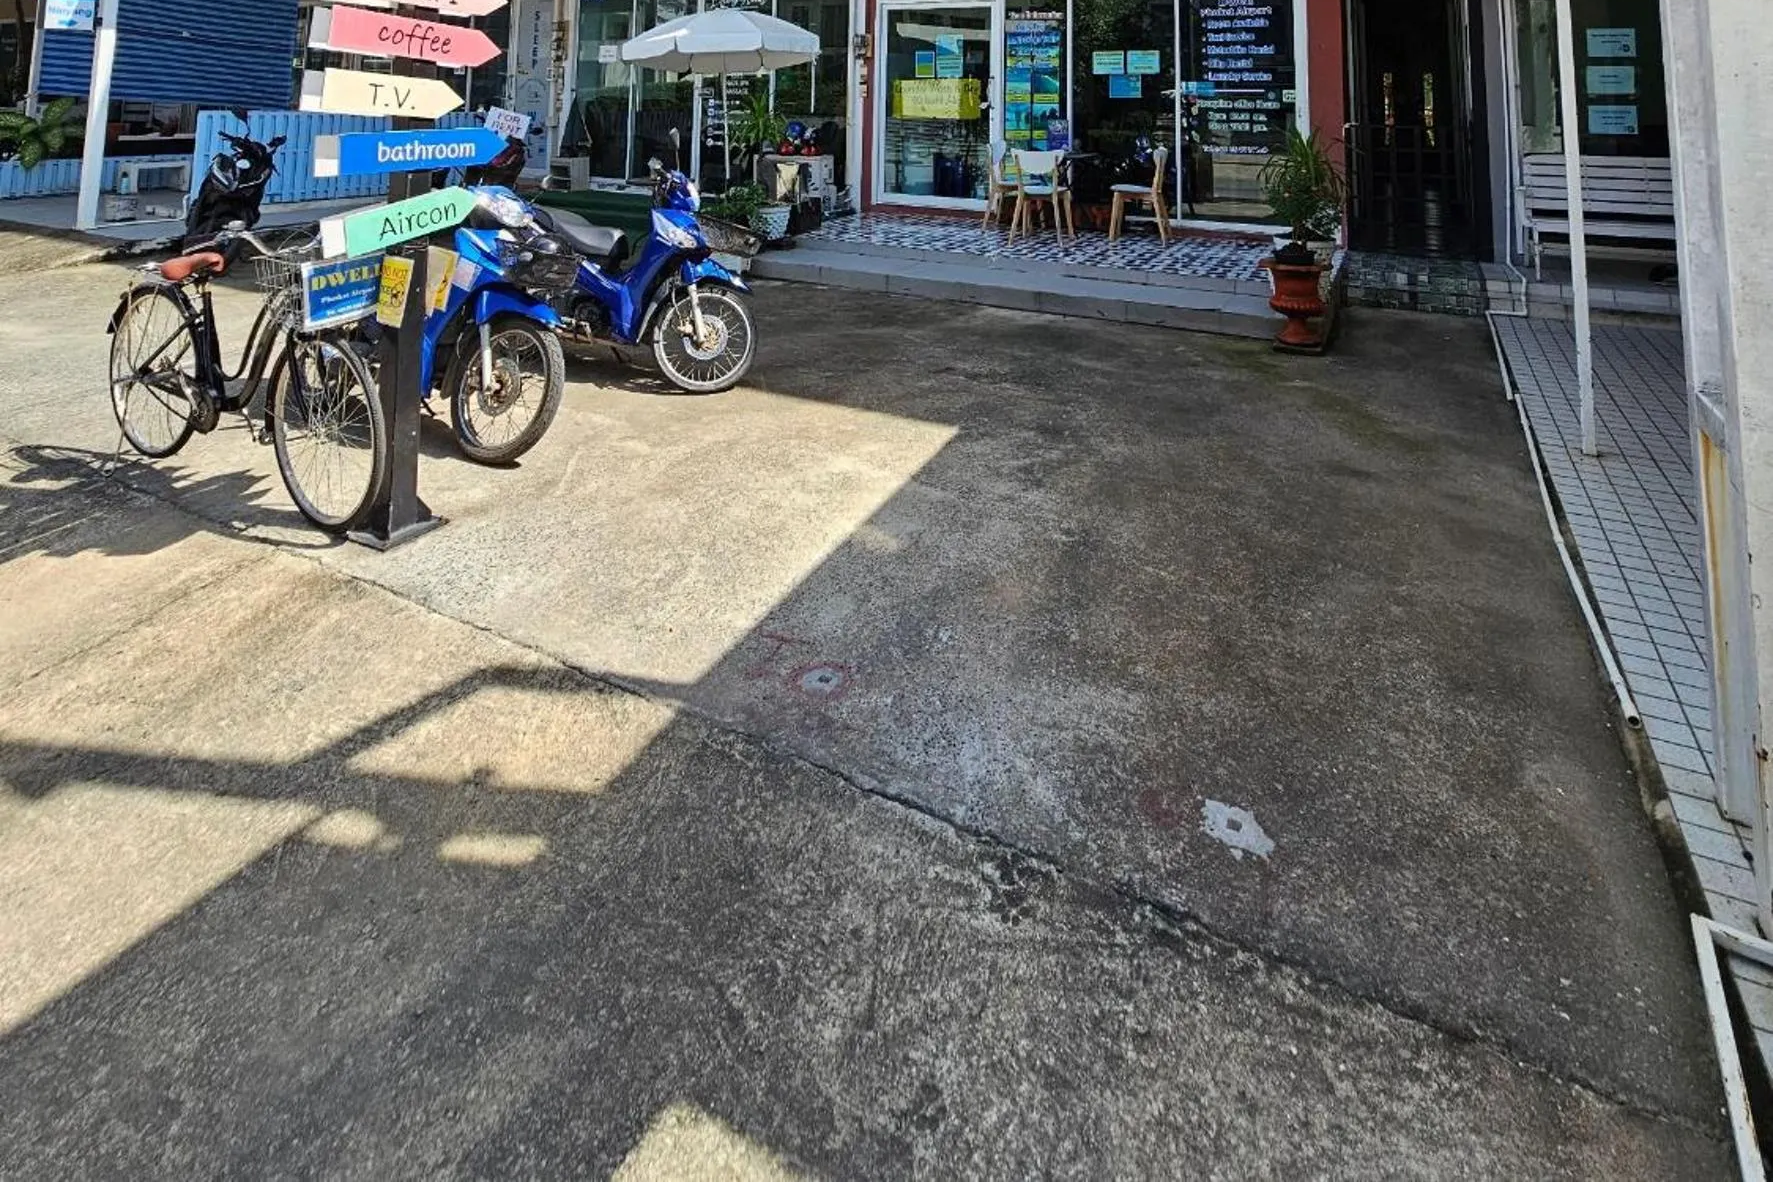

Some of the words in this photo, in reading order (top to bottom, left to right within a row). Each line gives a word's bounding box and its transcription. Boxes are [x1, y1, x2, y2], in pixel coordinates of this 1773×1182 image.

[378, 23, 452, 58] coffee
[531, 10, 541, 70] SLEEP
[491, 120, 521, 134] RENT
[497, 112, 521, 124] FOR
[377, 141, 476, 163] bathroom
[379, 200, 457, 242] Aircon
